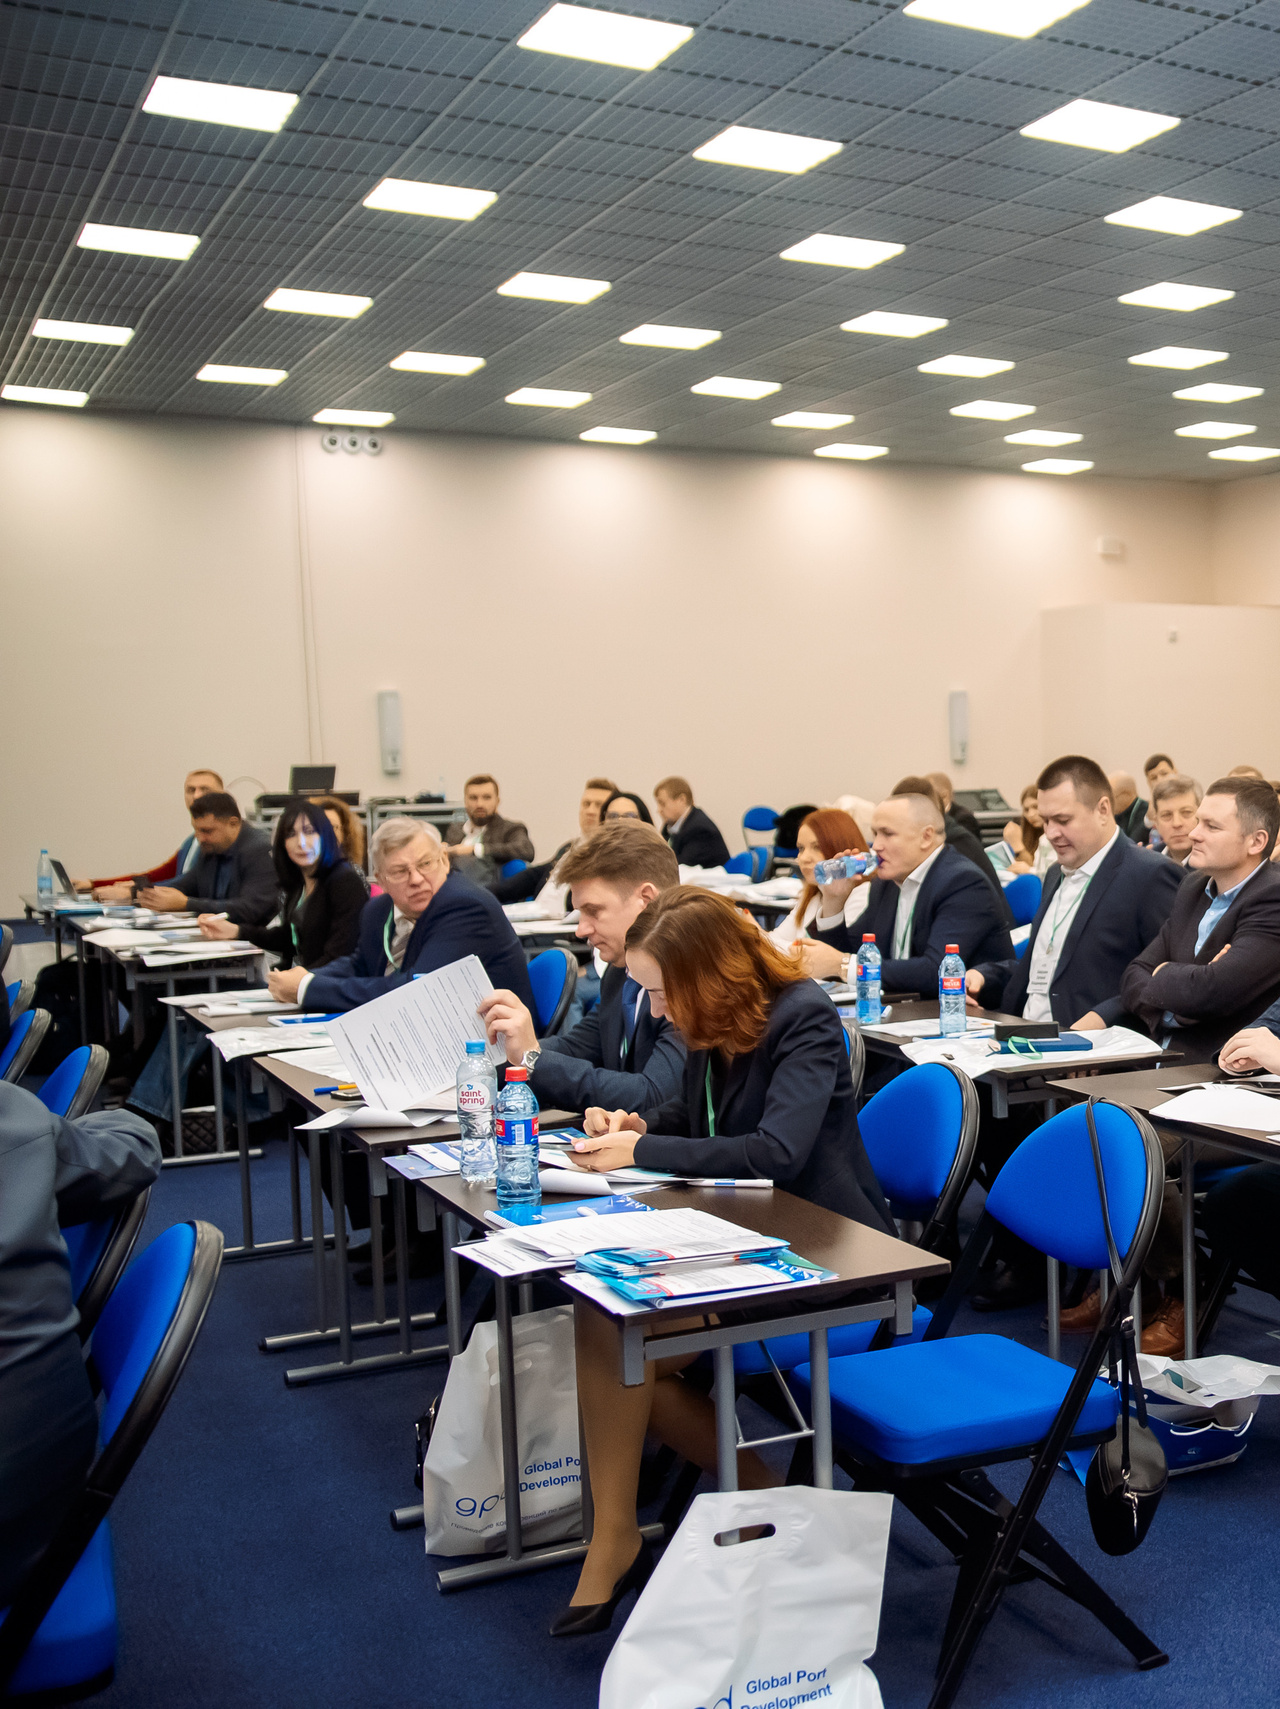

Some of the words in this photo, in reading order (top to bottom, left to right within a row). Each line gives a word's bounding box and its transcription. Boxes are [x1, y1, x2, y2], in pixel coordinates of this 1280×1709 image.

[459, 1097, 485, 1105] spring
[524, 1458, 562, 1475] Global
[565, 1456, 581, 1468] Po
[519, 1473, 582, 1493] Developm
[455, 1489, 506, 1519] gp
[746, 1671, 792, 1695] Global
[796, 1667, 828, 1684] Port
